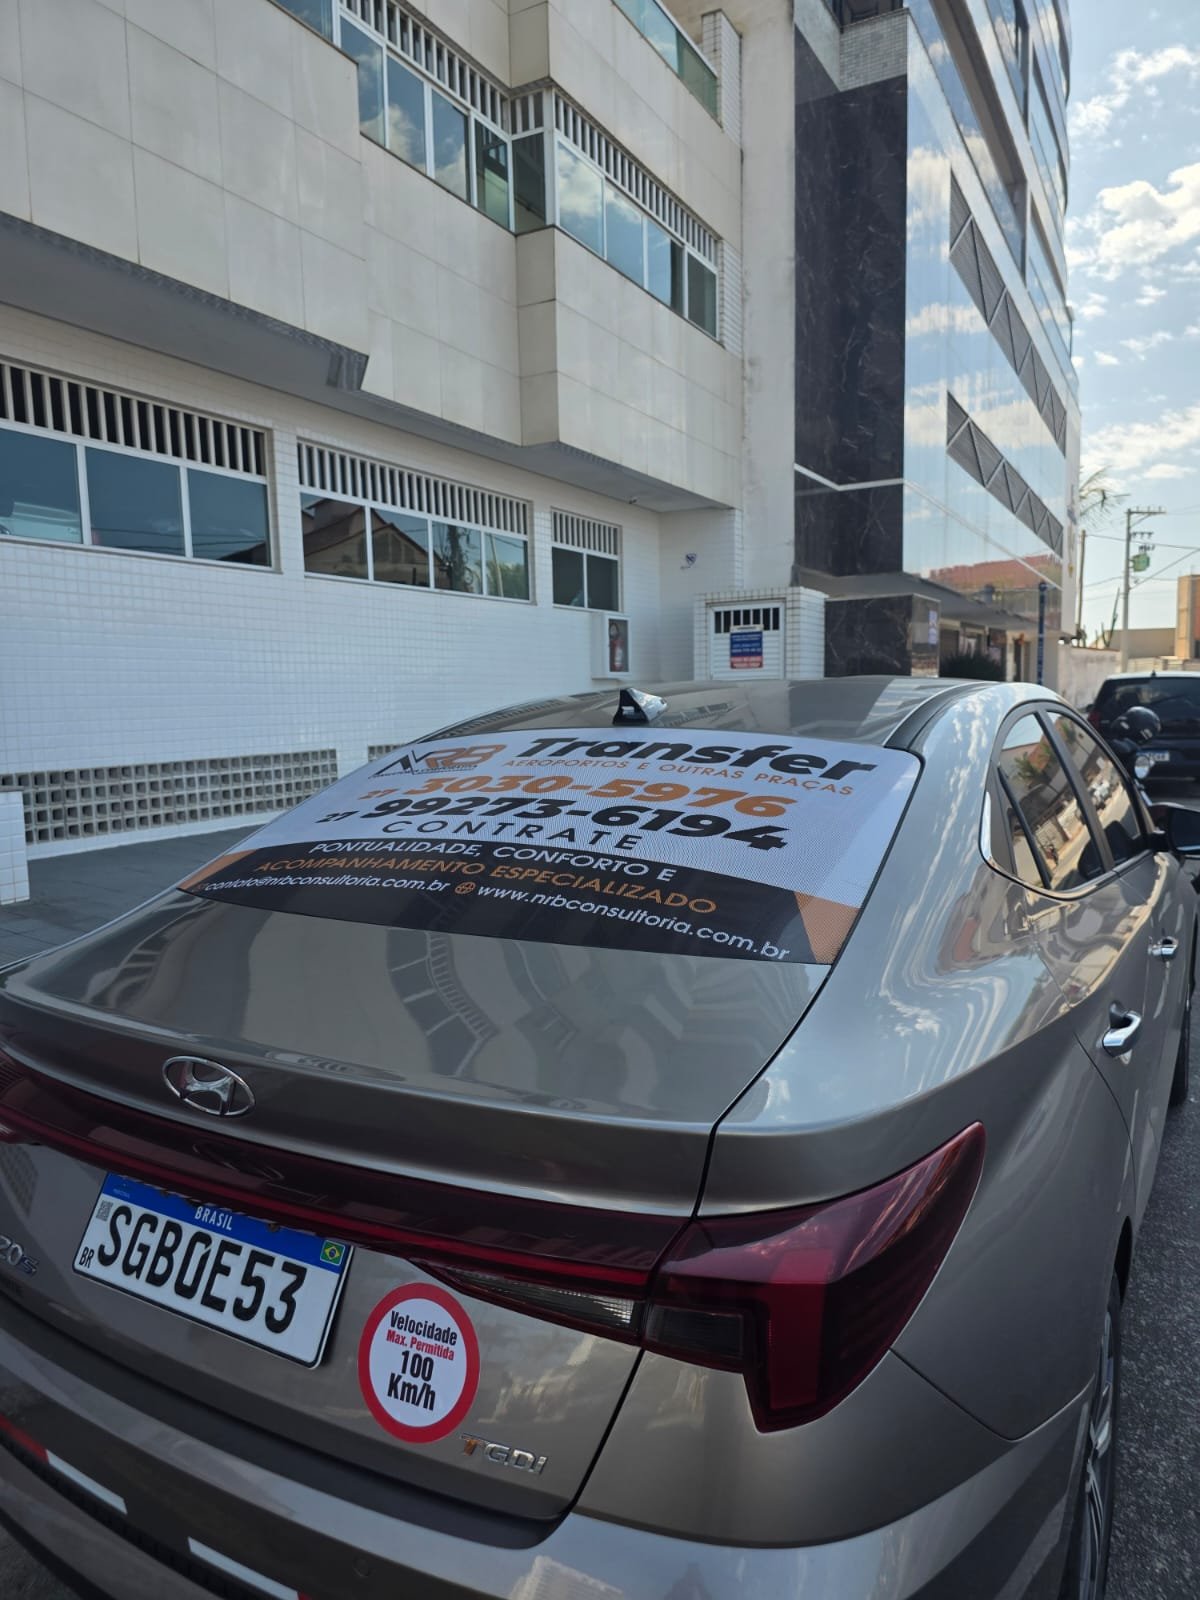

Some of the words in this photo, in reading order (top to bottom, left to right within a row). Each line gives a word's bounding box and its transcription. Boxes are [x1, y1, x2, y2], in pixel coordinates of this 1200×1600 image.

[503, 759, 627, 769] AEROPORTOS
[637, 762, 650, 770] E
[659, 764, 744, 779] OUTRAS
[754, 773, 854, 797] PRAÇAS
[517, 737, 878, 783] Transfer
[402, 775, 799, 818] 3030-5976
[315, 810, 359, 823] 27
[360, 797, 791, 851] 99273-6194
[382, 820, 643, 850] CONTRATE
[309, 842, 482, 857] PONTUALIDADE,
[492, 847, 650, 876] CONFORTO
[658, 868, 677, 882] E
[254, 857, 485, 875] ACOMPANHAMENTO
[489, 865, 717, 914] ESPECIALIZADO
[205, 875, 450, 892] contato@nrbconsultoria.com.br
[478, 885, 790, 961] www.nrbconsultoria.com.br
[194, 1205, 233, 1231] BRASIL
[79, 1246, 94, 1269] BR
[386, 1329, 408, 1347] Max.
[409, 1336, 454, 1361] Permitida
[390, 1310, 457, 1346] Velocidade
[400, 1350, 434, 1382] 100
[387, 1373, 436, 1411] Km/h
